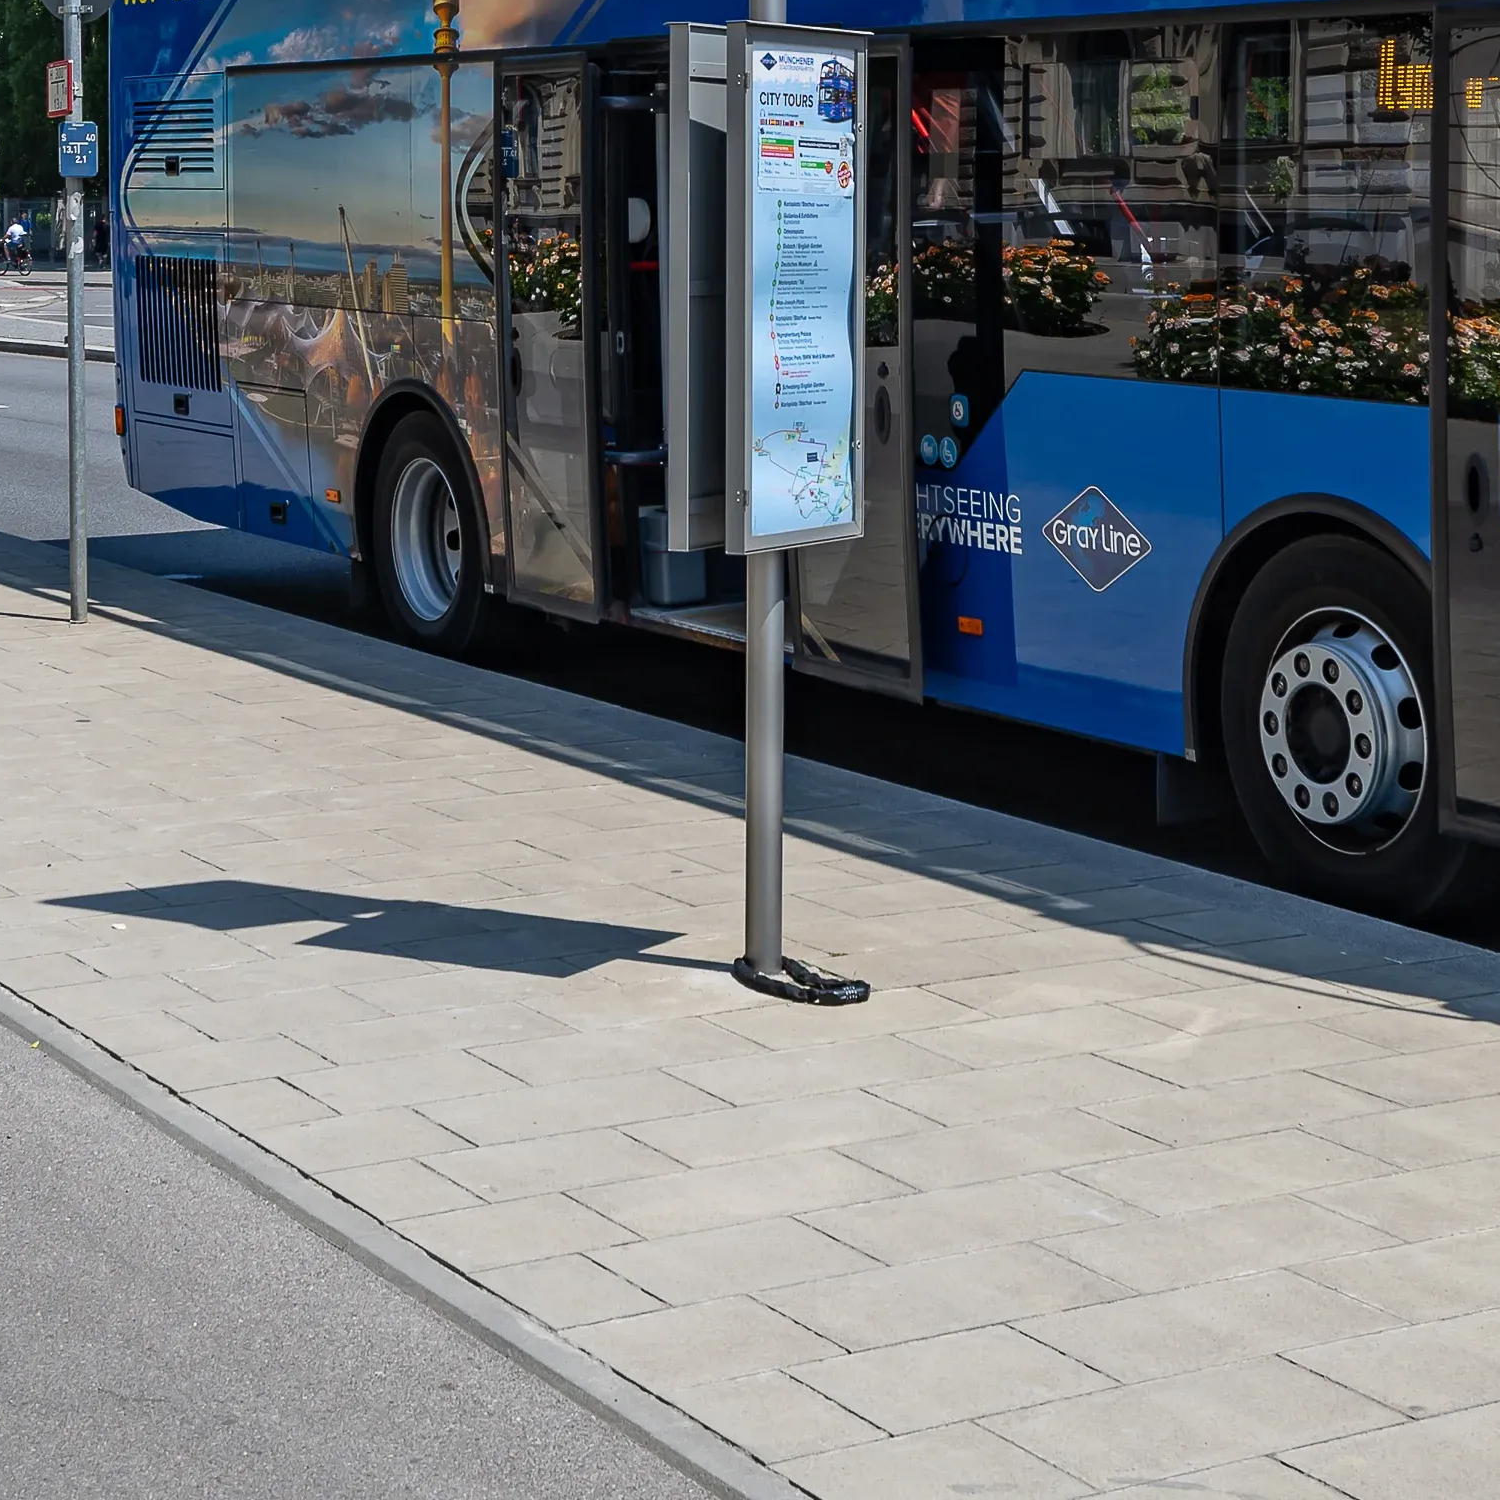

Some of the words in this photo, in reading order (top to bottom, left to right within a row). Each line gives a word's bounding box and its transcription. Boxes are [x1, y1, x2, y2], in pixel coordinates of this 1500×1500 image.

[779, 54, 815, 66] MÜNCHENER
[759, 92, 781, 106] CITY
[783, 92, 814, 108] TOURS
[61, 133, 67, 142] S
[85, 133, 96, 142] 40
[62, 145, 77, 154] 13.1
[75, 155, 87, 164] 2.1
